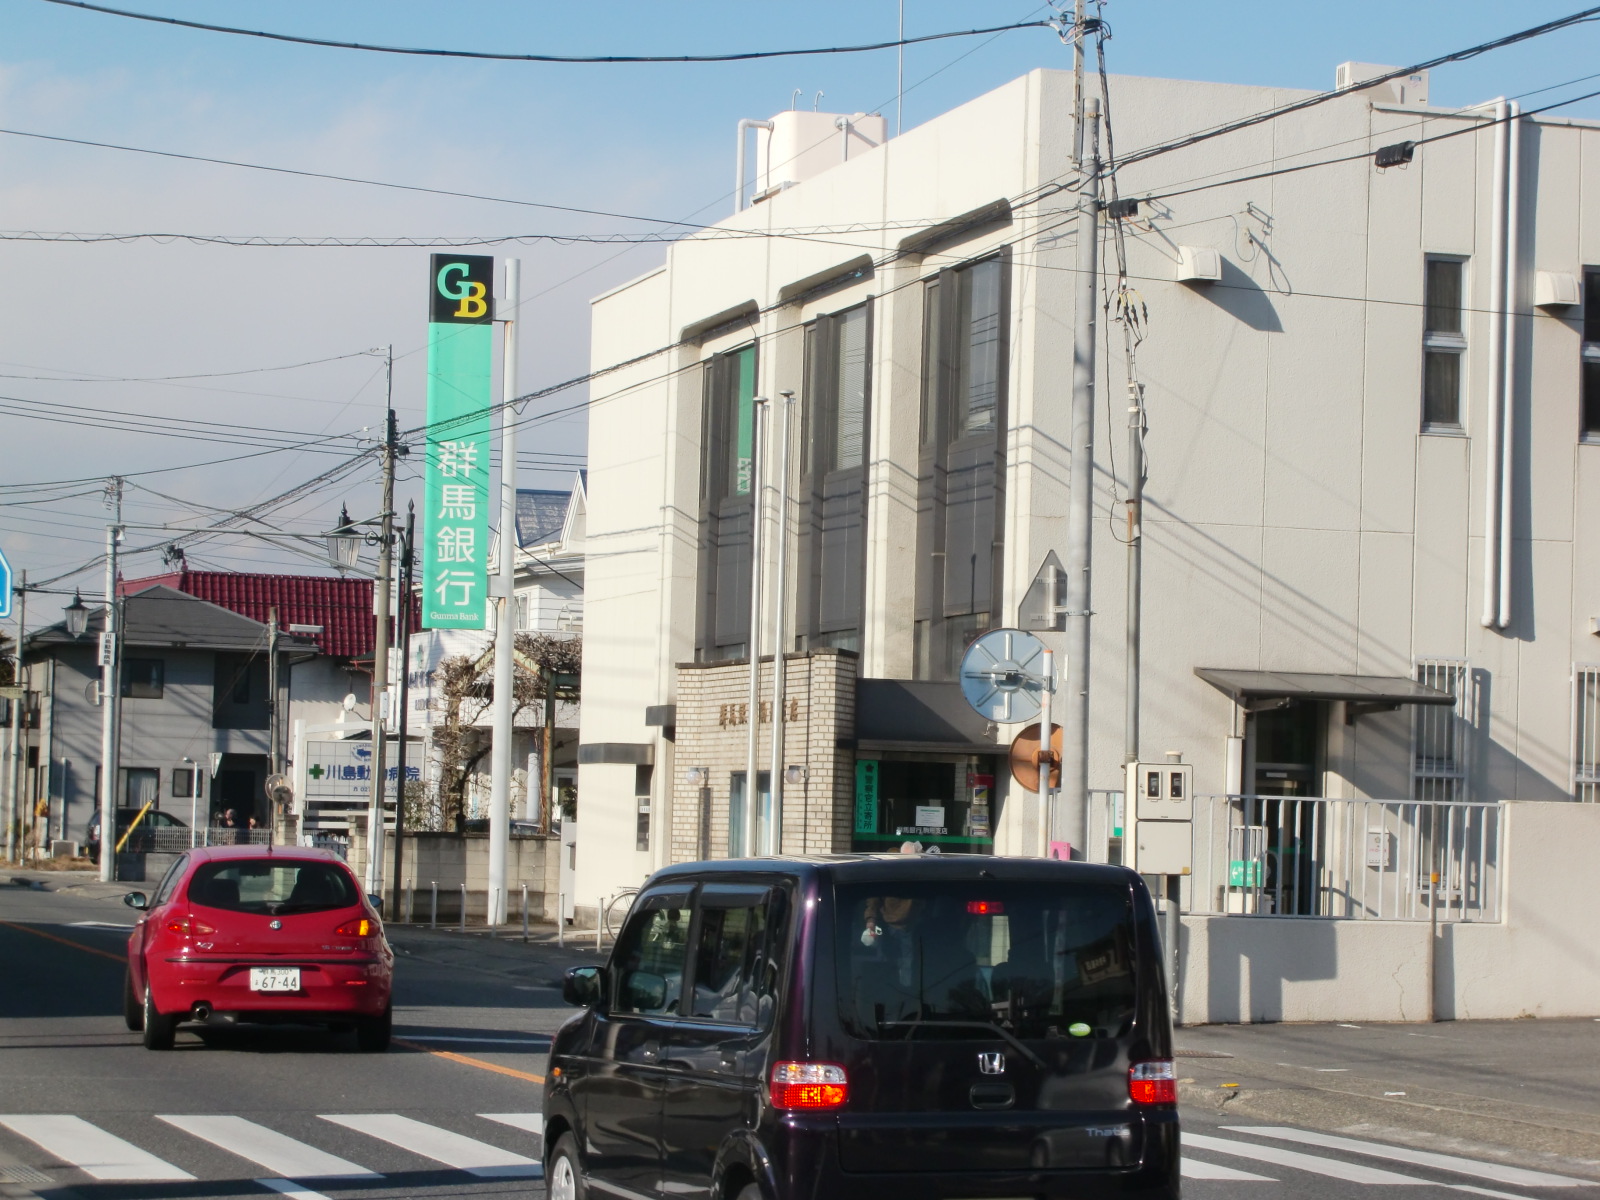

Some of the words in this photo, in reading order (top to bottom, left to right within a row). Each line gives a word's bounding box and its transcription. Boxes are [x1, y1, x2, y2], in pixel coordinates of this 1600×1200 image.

[437, 263, 487, 318] GB
[435, 441, 478, 606] 群馬銀行
[430, 612, 458, 620] Gunma
[460, 613, 479, 621] Bank
[326, 764, 420, 782] 川島動病院
[262, 976, 297, 989] 67-44
